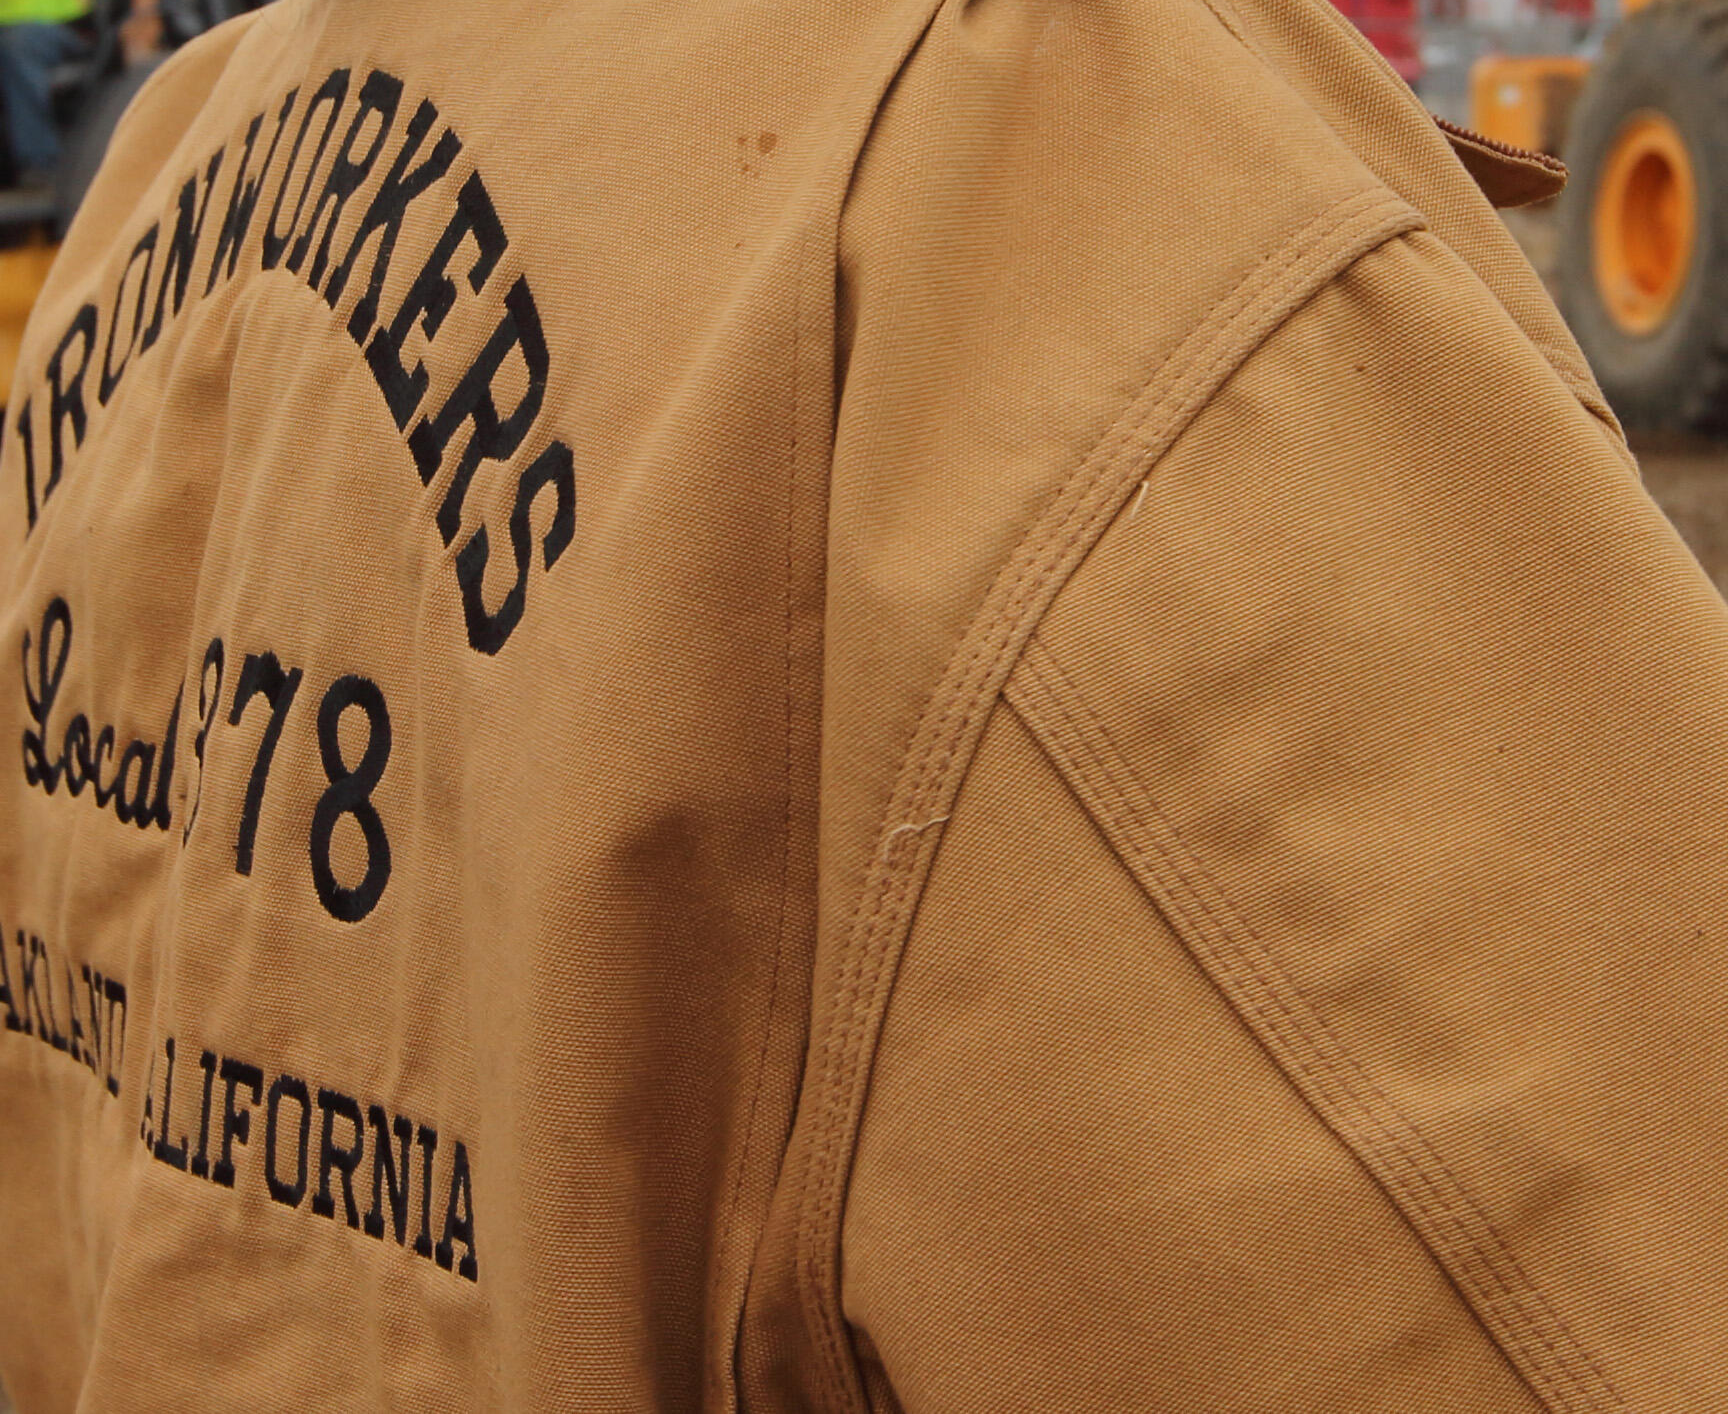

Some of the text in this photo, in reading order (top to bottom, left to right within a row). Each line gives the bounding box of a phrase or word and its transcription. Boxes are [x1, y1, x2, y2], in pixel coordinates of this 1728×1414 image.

[16, 67, 576, 656] IRONWORKERS
[20, 595, 185, 832] Local
[139, 1036, 478, 1283] ALIFORNIA
